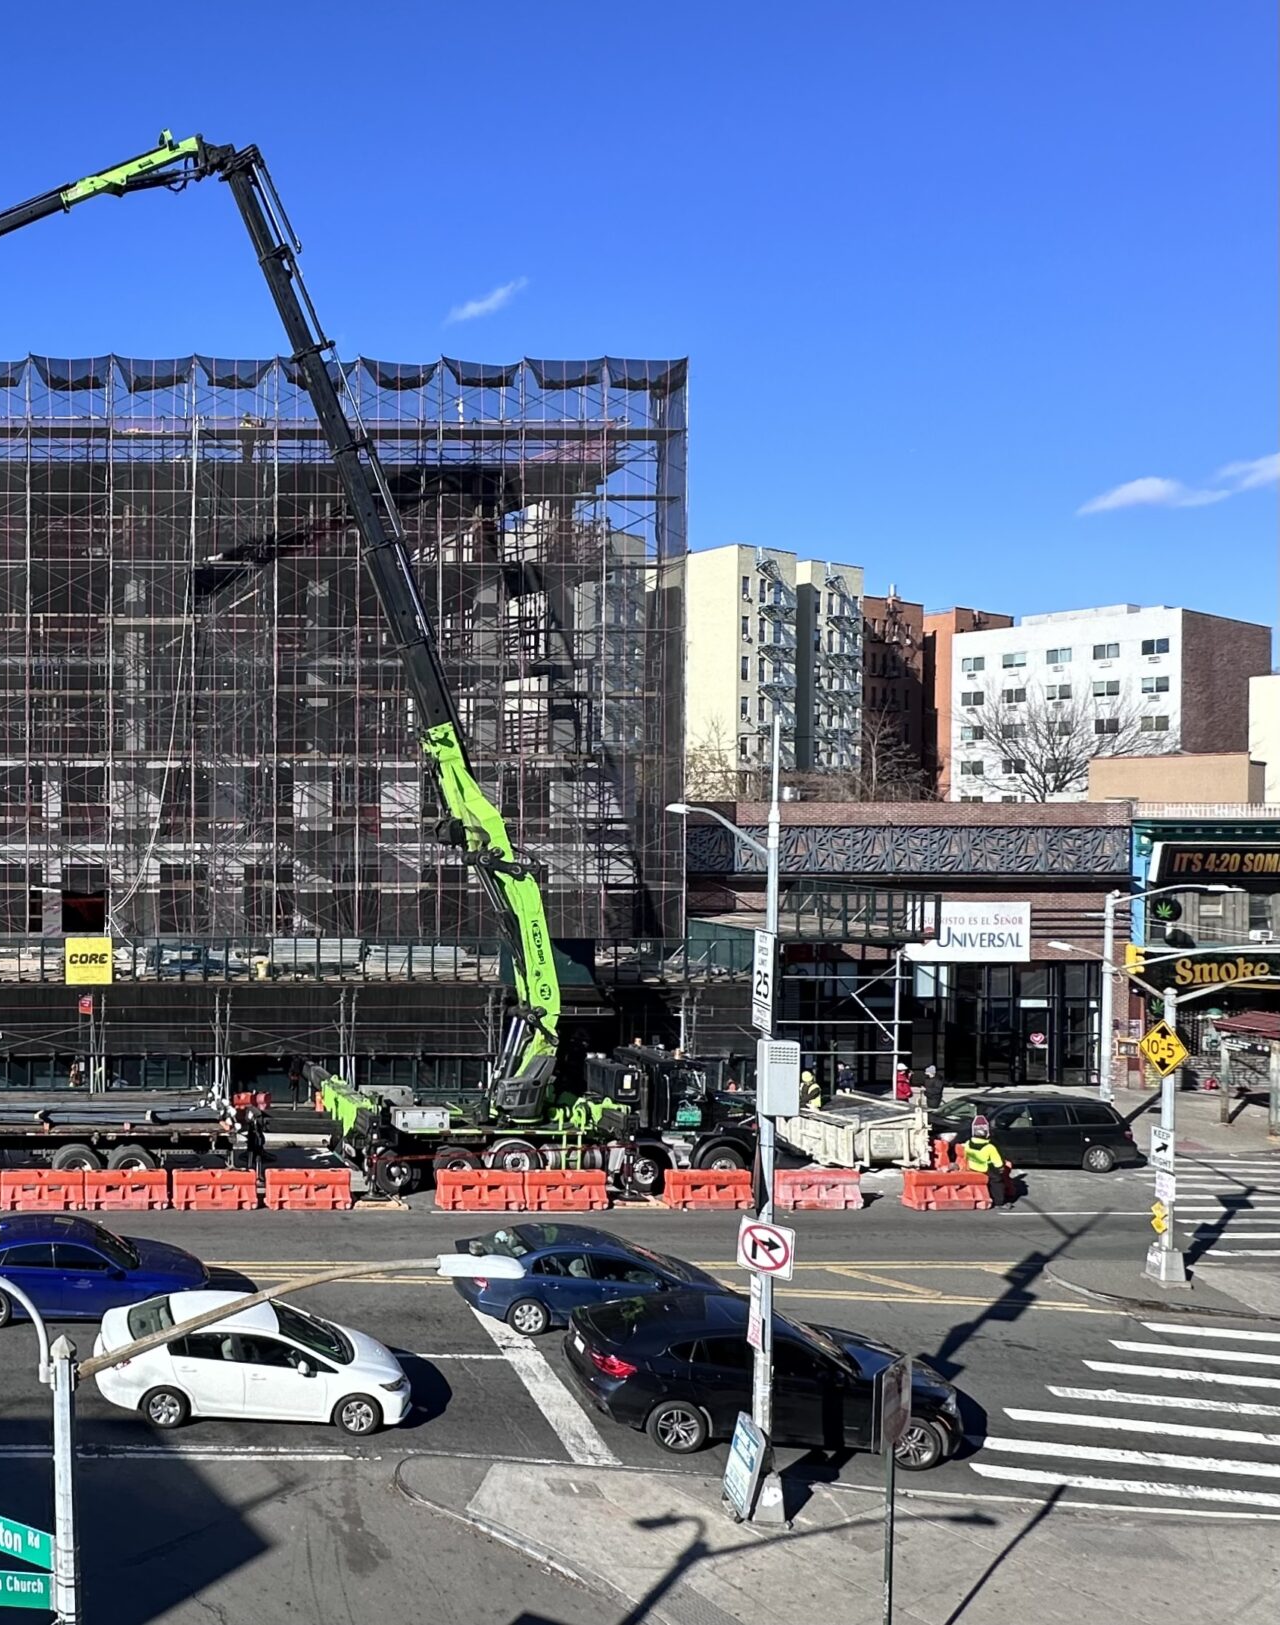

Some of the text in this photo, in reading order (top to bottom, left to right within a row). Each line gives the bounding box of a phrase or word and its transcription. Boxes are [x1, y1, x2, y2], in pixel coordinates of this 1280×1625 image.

[1173, 852, 1280, 873] IT'S 4:20 SOM
[968, 916, 978, 926] ES
[981, 916, 991, 926] EL
[937, 926, 1024, 948] UNIVERSAL
[69, 953, 108, 965] CORE
[1175, 957, 1271, 986] Smoke
[756, 969, 770, 1000] 25
[1152, 1129, 1171, 1141] KEEP
[1152, 1155, 1172, 1169] RIGHT
[27, 1530, 41, 1549] Rd
[6, 1575, 44, 1594] Church
